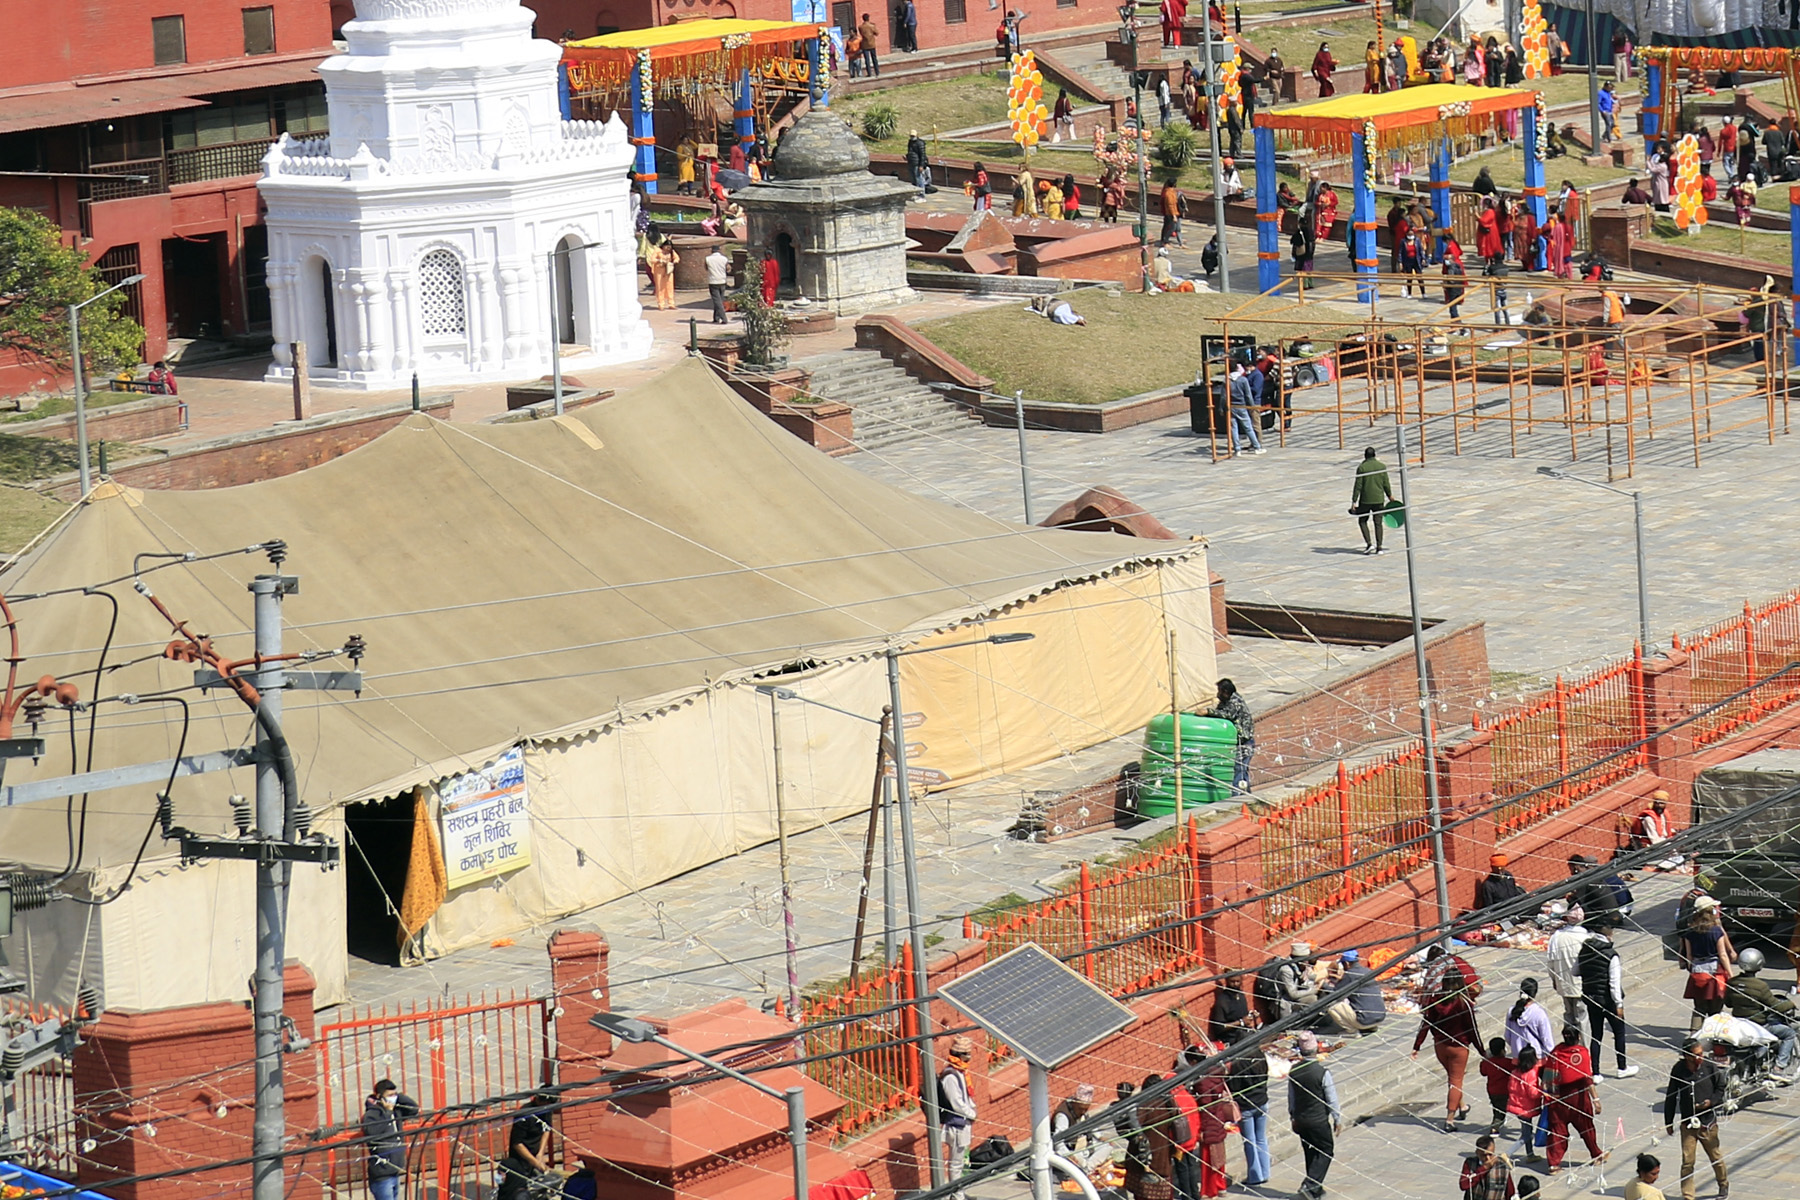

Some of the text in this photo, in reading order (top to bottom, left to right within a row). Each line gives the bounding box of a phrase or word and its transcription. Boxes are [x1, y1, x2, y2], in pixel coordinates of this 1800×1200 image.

[482, 800, 505, 824] प्रहरी
[508, 798, 523, 813] बल
[484, 821, 511, 843] शिविर
[498, 842, 518, 858] पोष्ट
